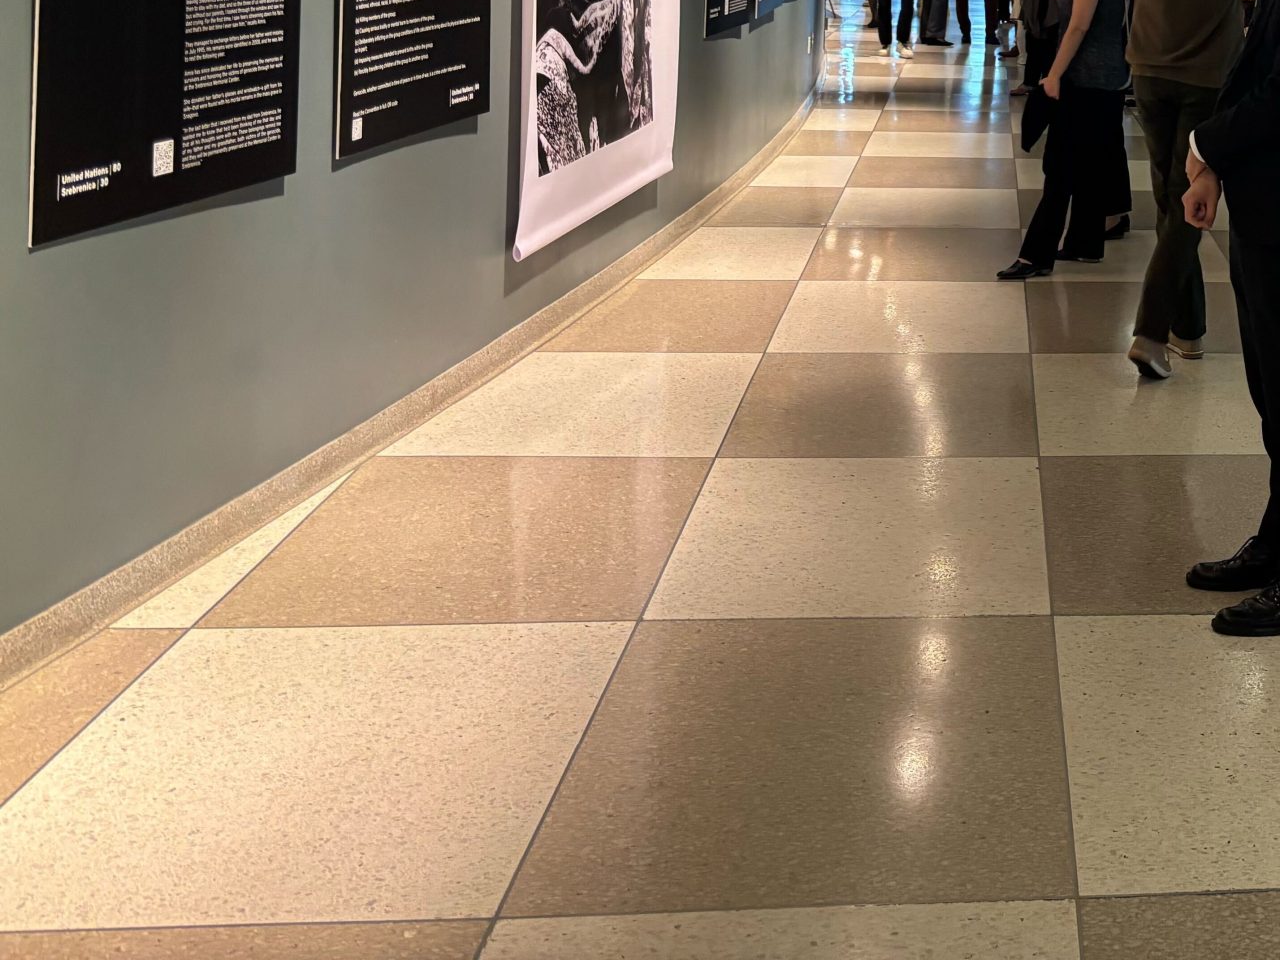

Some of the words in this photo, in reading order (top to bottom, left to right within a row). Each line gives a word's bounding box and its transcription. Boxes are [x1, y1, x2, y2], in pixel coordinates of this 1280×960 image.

[62, 172, 84, 184] United
[85, 167, 109, 179] Nations
[112, 162, 121, 172] 80
[61, 182, 96, 197] Srebrenica
